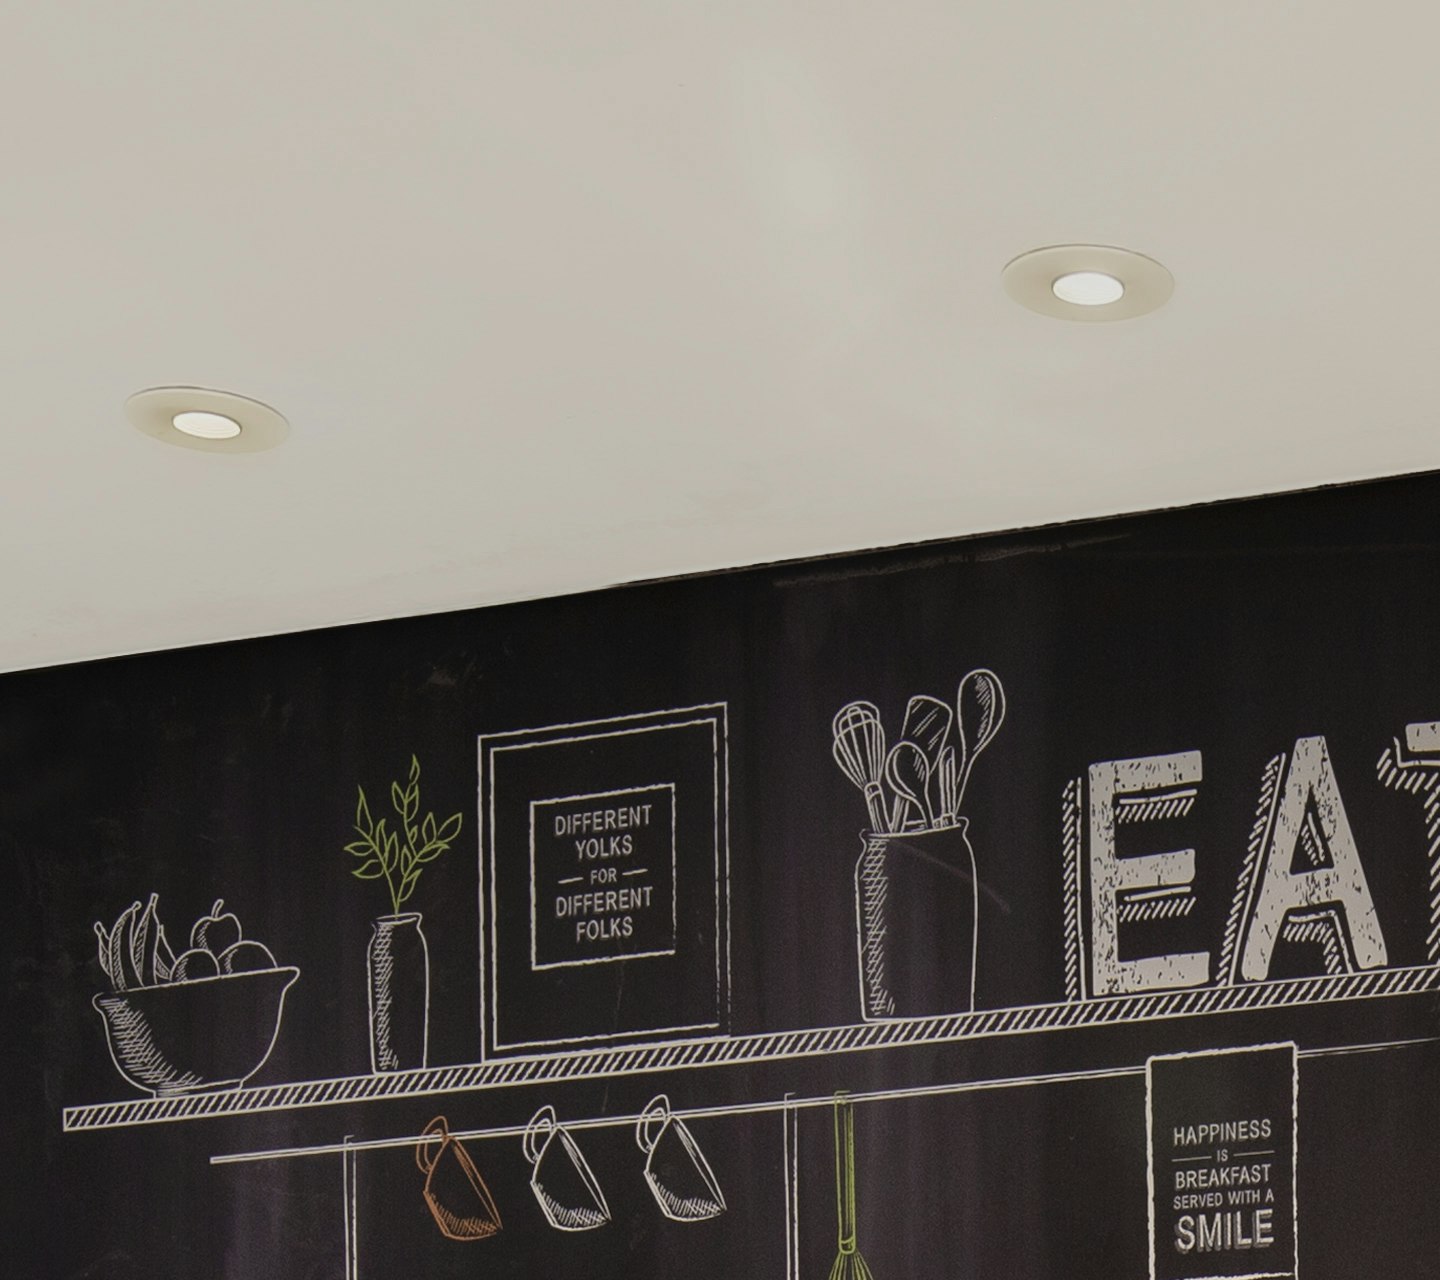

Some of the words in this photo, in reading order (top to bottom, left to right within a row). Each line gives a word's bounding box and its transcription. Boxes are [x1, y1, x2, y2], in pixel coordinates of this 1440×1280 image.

[555, 804, 652, 836] DIFFERENT
[575, 835, 633, 860] YOLKS
[590, 867, 618, 885] FOR
[555, 886, 653, 918] DIFFERENT
[576, 916, 633, 943] FOLKS
[1173, 1119, 1272, 1145] HAPPINESS
[1217, 1149, 1228, 1163] IS
[1175, 1164, 1271, 1189] BREAKFAST
[1173, 1192, 1223, 1209] SERVED
[1228, 1190, 1260, 1205] WITH
[1265, 1188, 1274, 1202] A
[1176, 1209, 1274, 1252] SMILE
